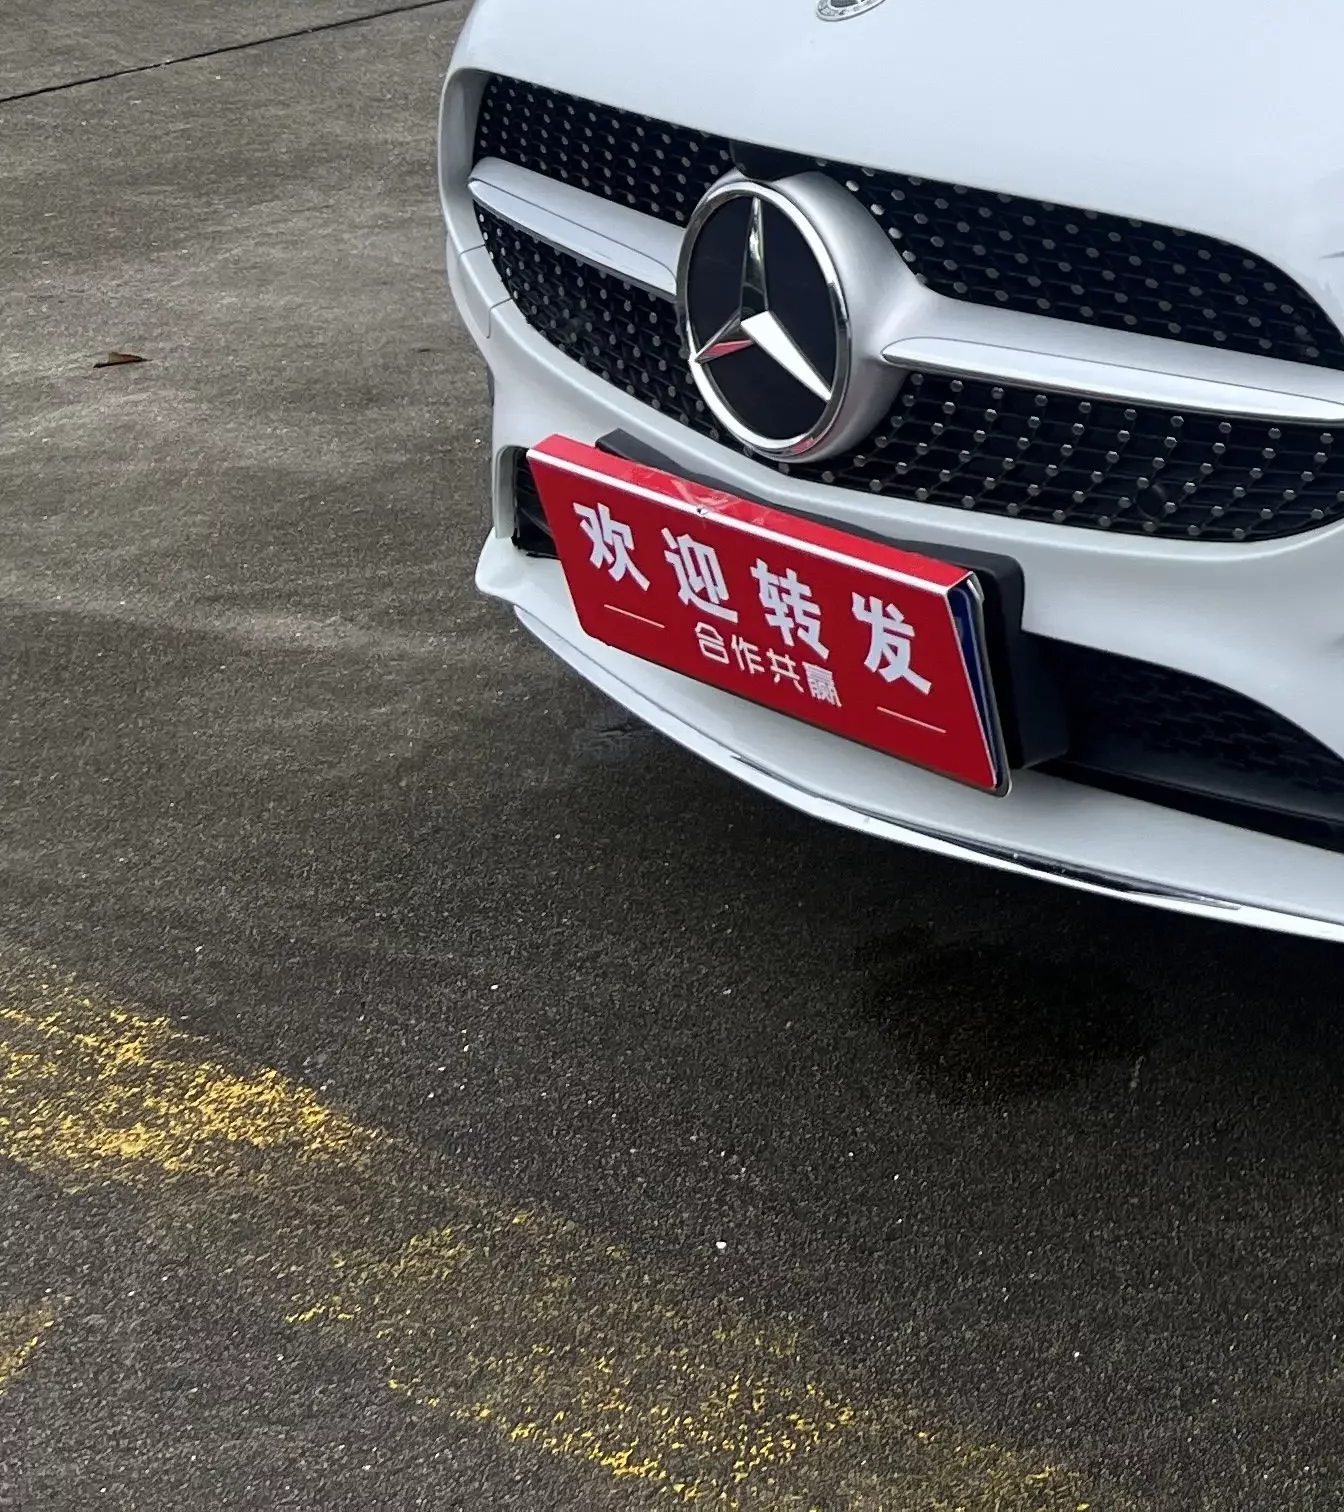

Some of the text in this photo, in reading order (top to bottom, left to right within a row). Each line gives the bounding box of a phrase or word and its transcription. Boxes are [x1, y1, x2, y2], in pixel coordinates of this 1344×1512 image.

[573, 502, 932, 696] 欢迎转发
[695, 621, 842, 707] 合作共赢
